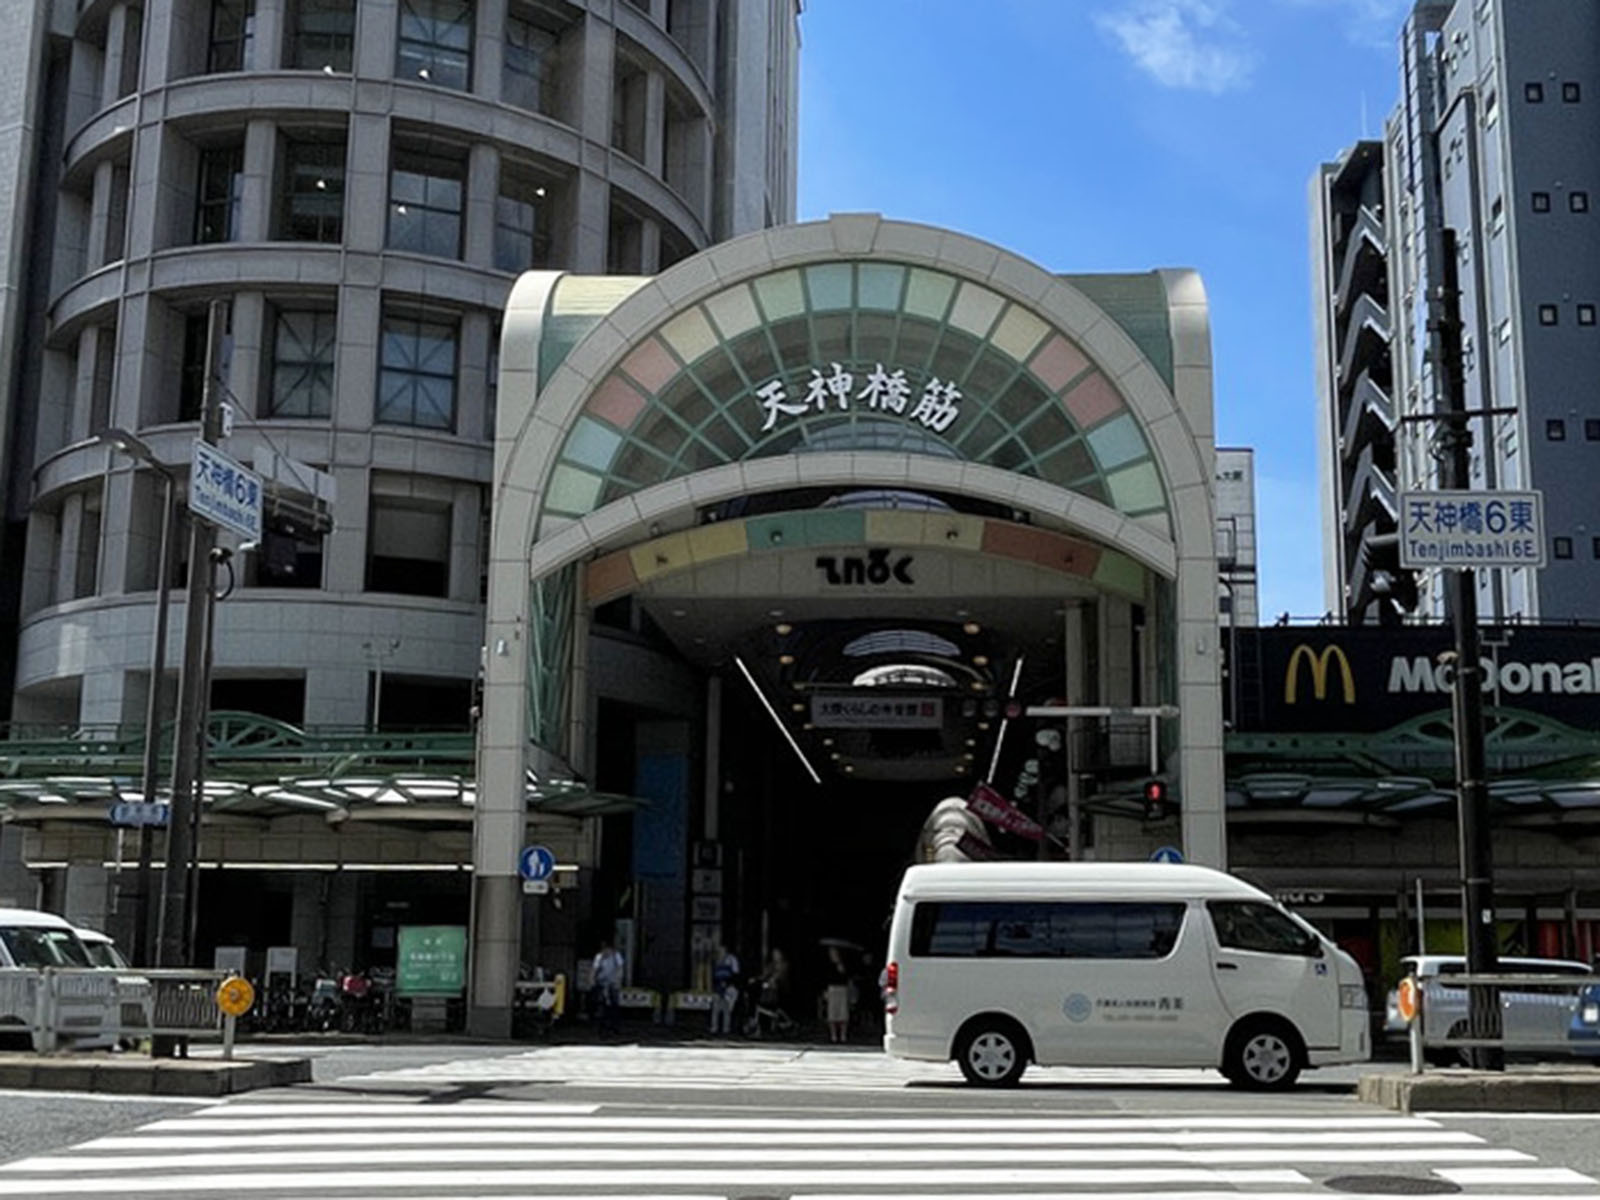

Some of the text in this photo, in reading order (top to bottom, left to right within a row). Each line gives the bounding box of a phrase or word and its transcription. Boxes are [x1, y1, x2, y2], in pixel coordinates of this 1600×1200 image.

[757, 362, 962, 432] 天神橋筋
[1408, 500, 1535, 535] 天神橋6東
